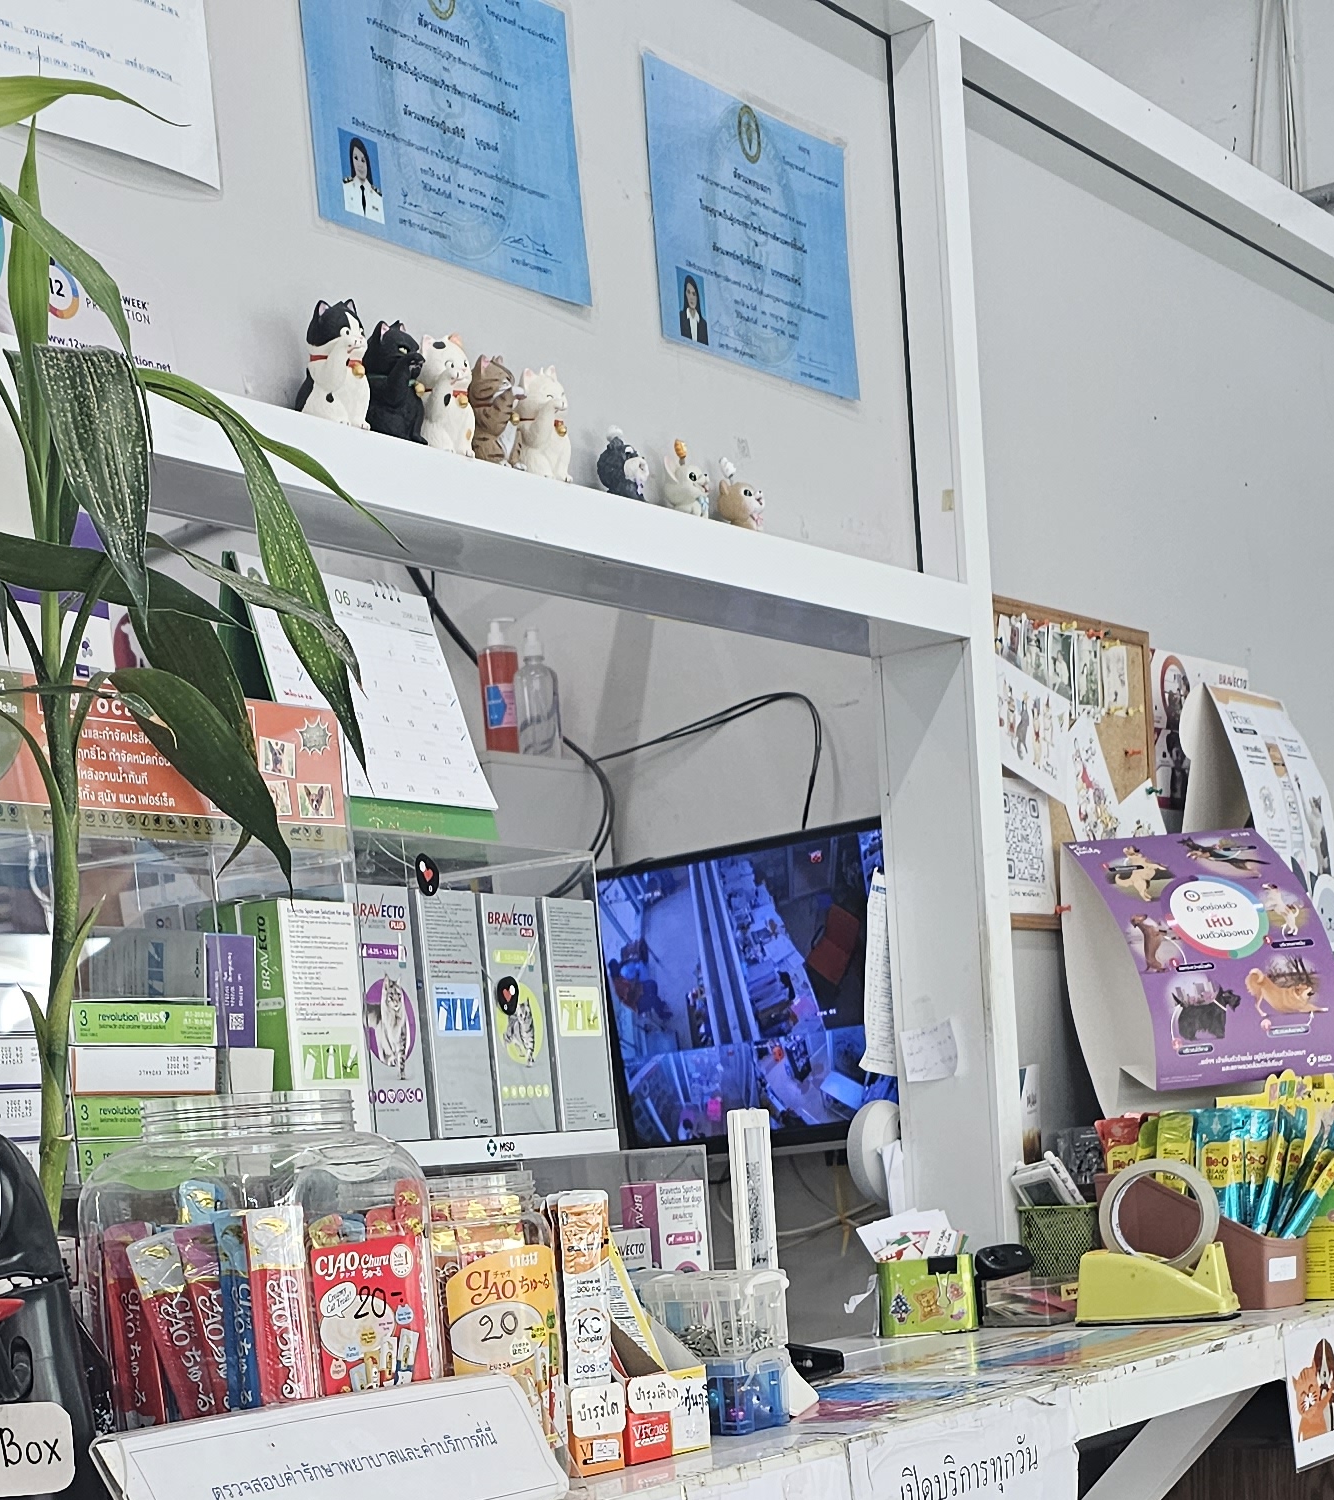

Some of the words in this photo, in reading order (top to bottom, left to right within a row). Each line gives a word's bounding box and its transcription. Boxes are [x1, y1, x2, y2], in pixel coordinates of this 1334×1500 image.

[335, 589, 351, 606] 06
[356, 598, 373, 611] June
[119, 794, 136, 804] แมว
[390, 921, 405, 929] PLUS
[487, 909, 534, 928] BRAVECTO
[520, 928, 533, 937] PLUS
[257, 915, 271, 991] BRAVECTO
[80, 1009, 88, 1026] 3
[98, 1012, 138, 1022] revolution
[138, 1012, 159, 1023] PLUS
[81, 1104, 89, 1120] 3
[99, 1106, 140, 1116] revolution
[500, 1142, 515, 1152] MSD
[315, 1252, 360, 1280] CIAO
[361, 1253, 389, 1269] Churu
[466, 1270, 516, 1305] CIAO
[161, 1296, 190, 1347] CIAO
[577, 1333, 603, 1344] Complex
[0, 1427, 62, 1467] Box
